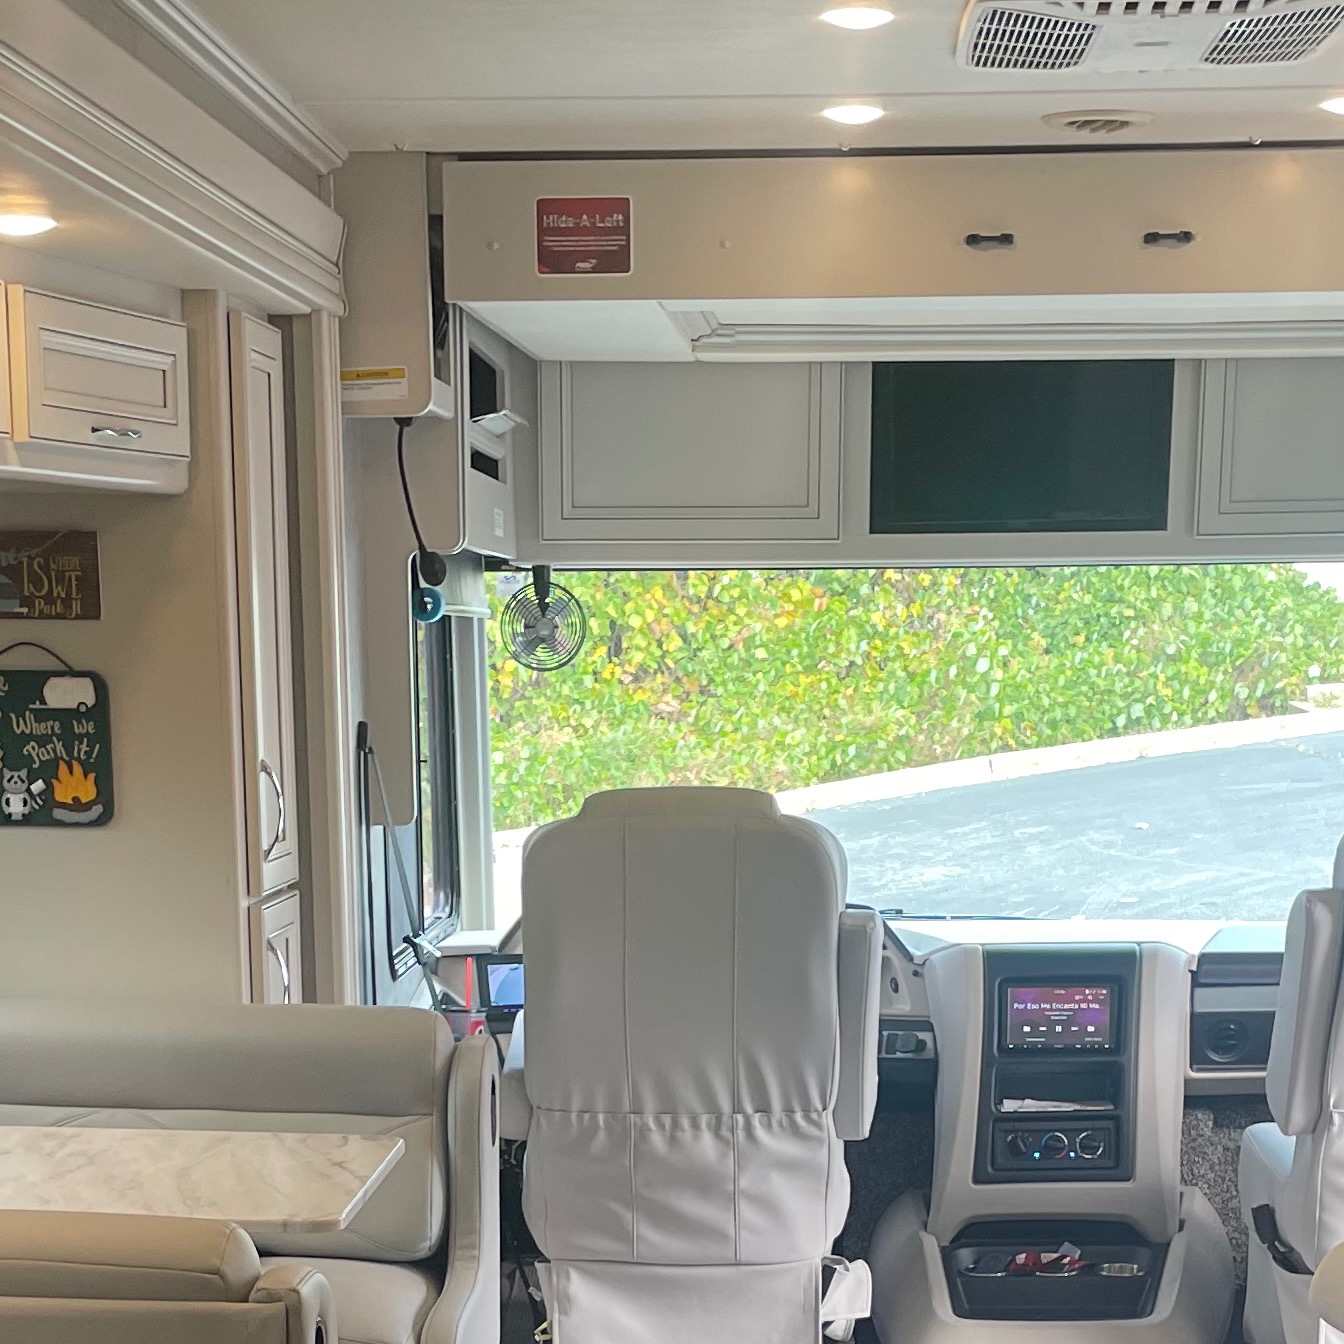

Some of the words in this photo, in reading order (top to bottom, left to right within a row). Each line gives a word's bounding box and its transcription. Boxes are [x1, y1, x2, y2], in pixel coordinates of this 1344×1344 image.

[22, 557, 48, 597] IS
[9, 711, 62, 736] Where
[72, 718, 96, 735] we
[23, 736, 67, 769] Park
